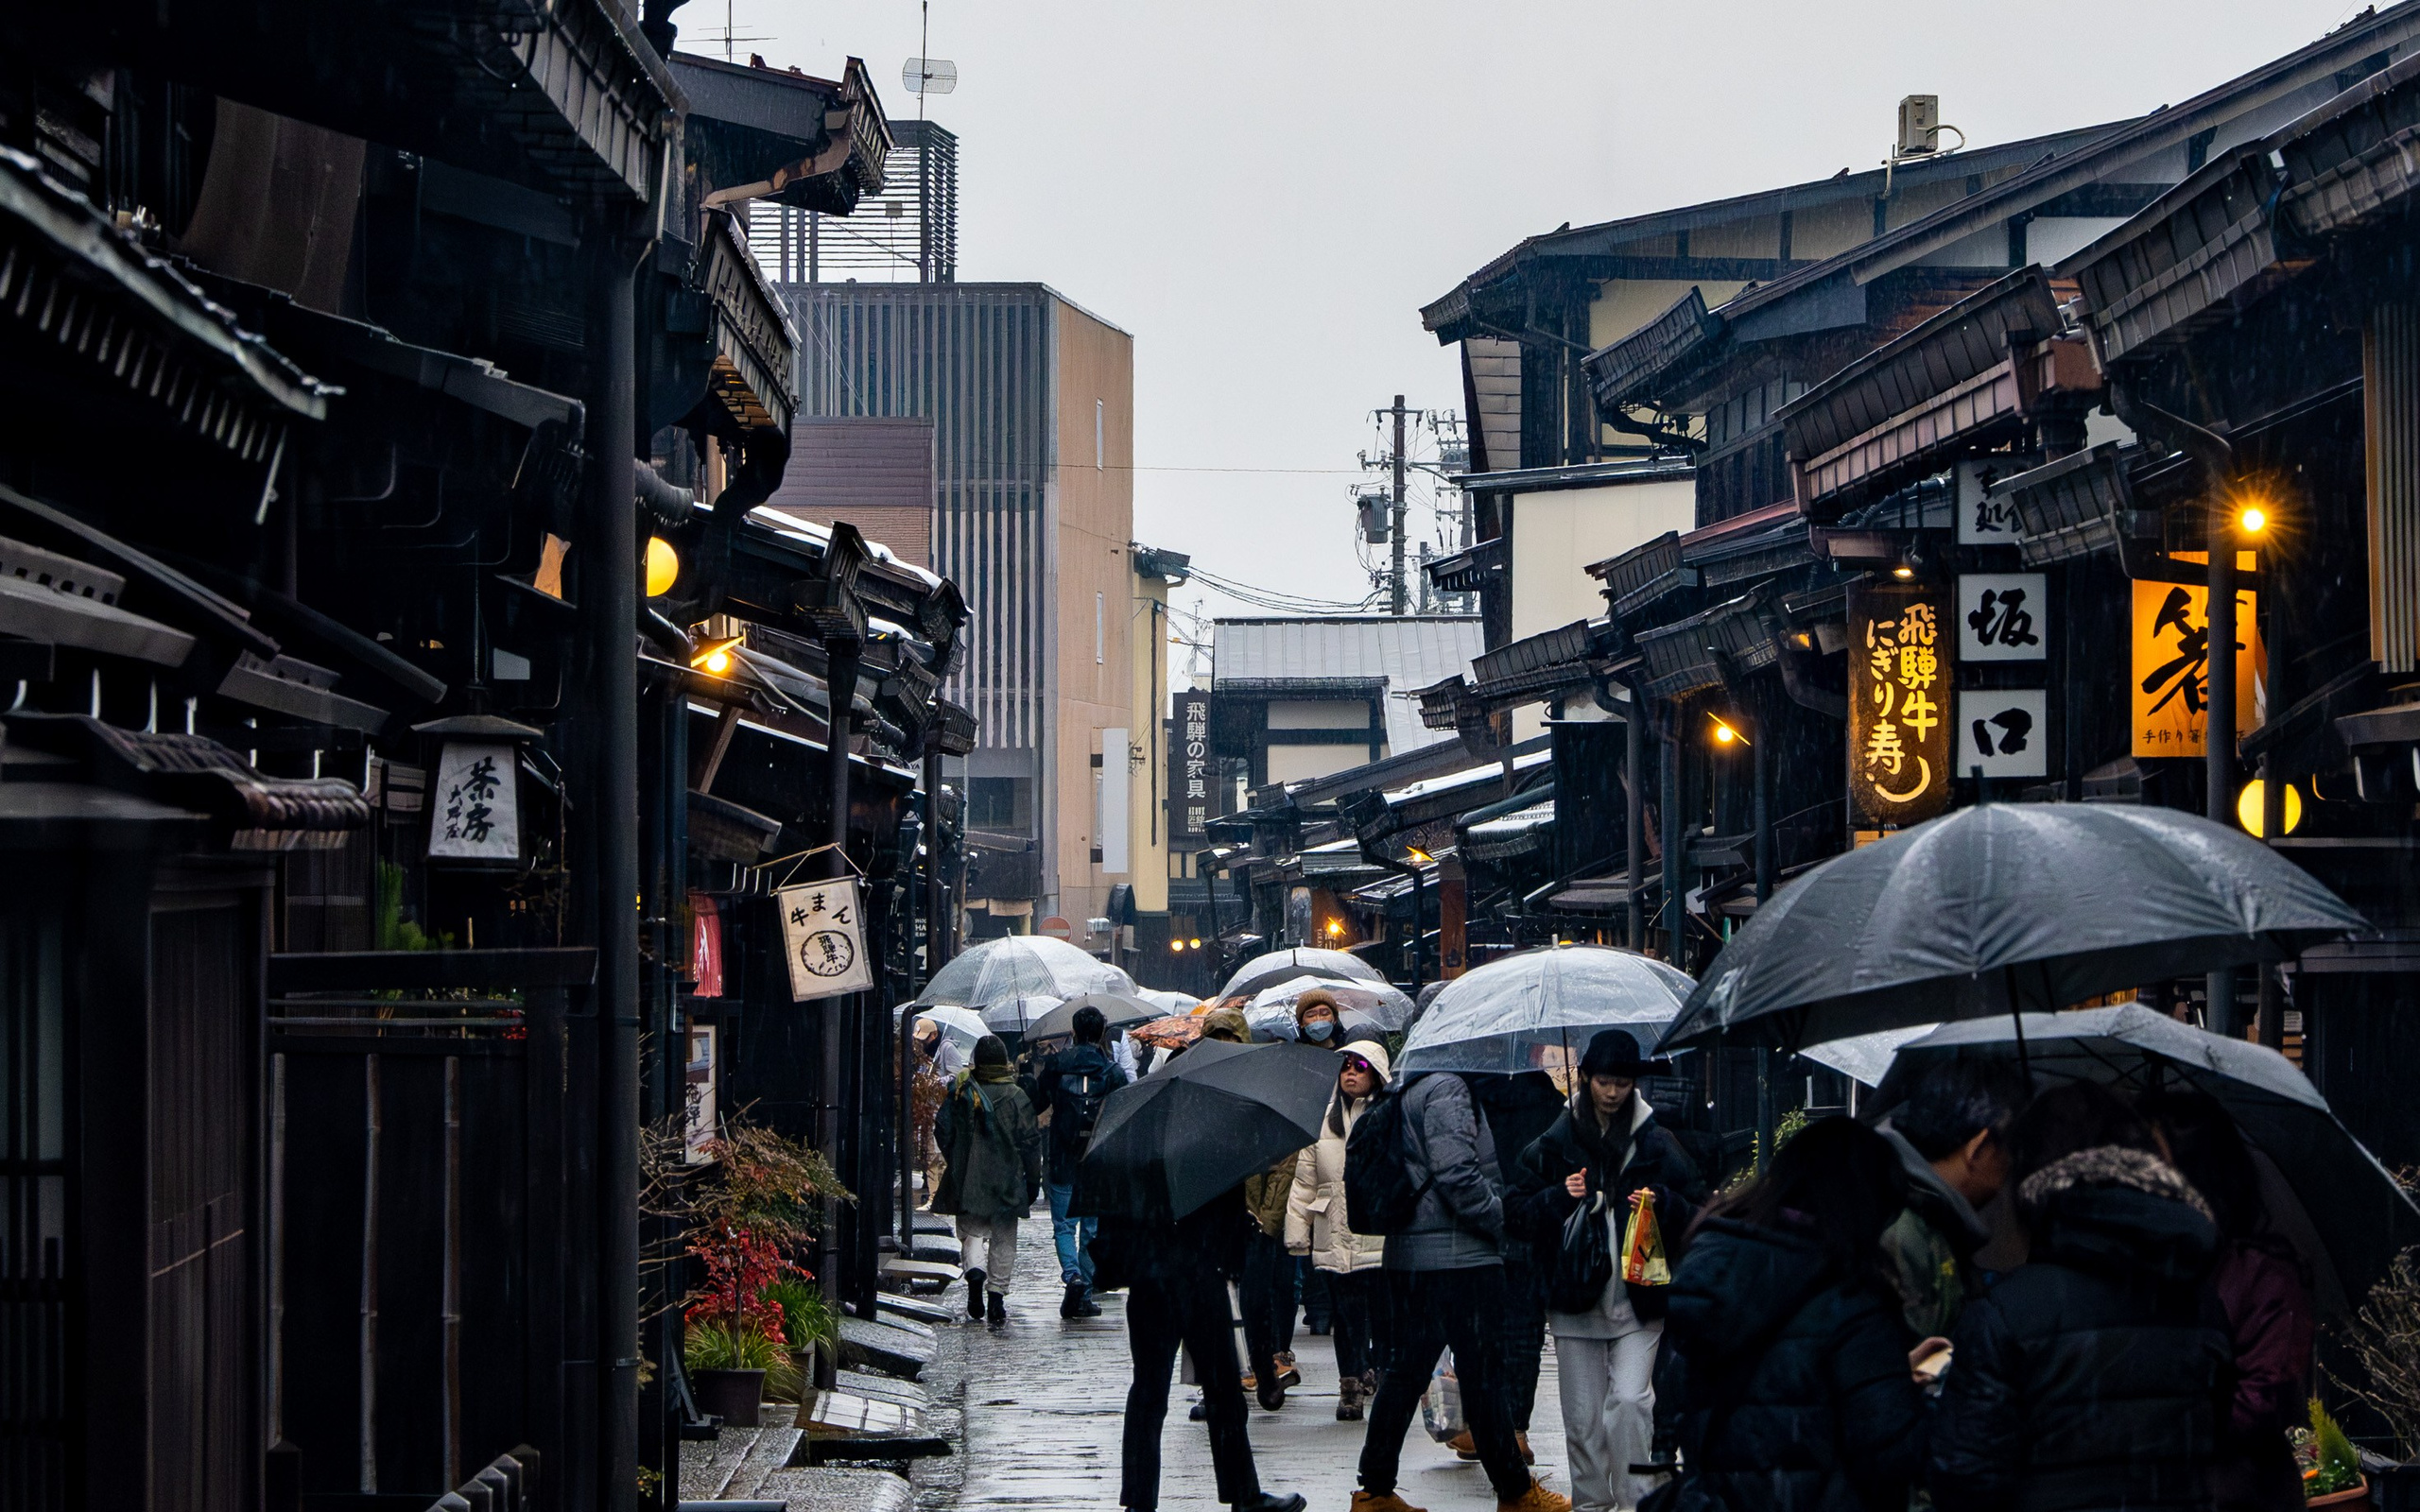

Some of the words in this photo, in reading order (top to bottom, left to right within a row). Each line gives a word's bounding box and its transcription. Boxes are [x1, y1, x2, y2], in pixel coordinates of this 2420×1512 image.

[1897, 602, 1938, 743] 飛騨牛
[1967, 588, 2039, 758] 坂口
[1185, 701, 1206, 799] 飛騨の家具
[460, 756, 501, 843] 茶房
[790, 892, 852, 927] 牛まん
